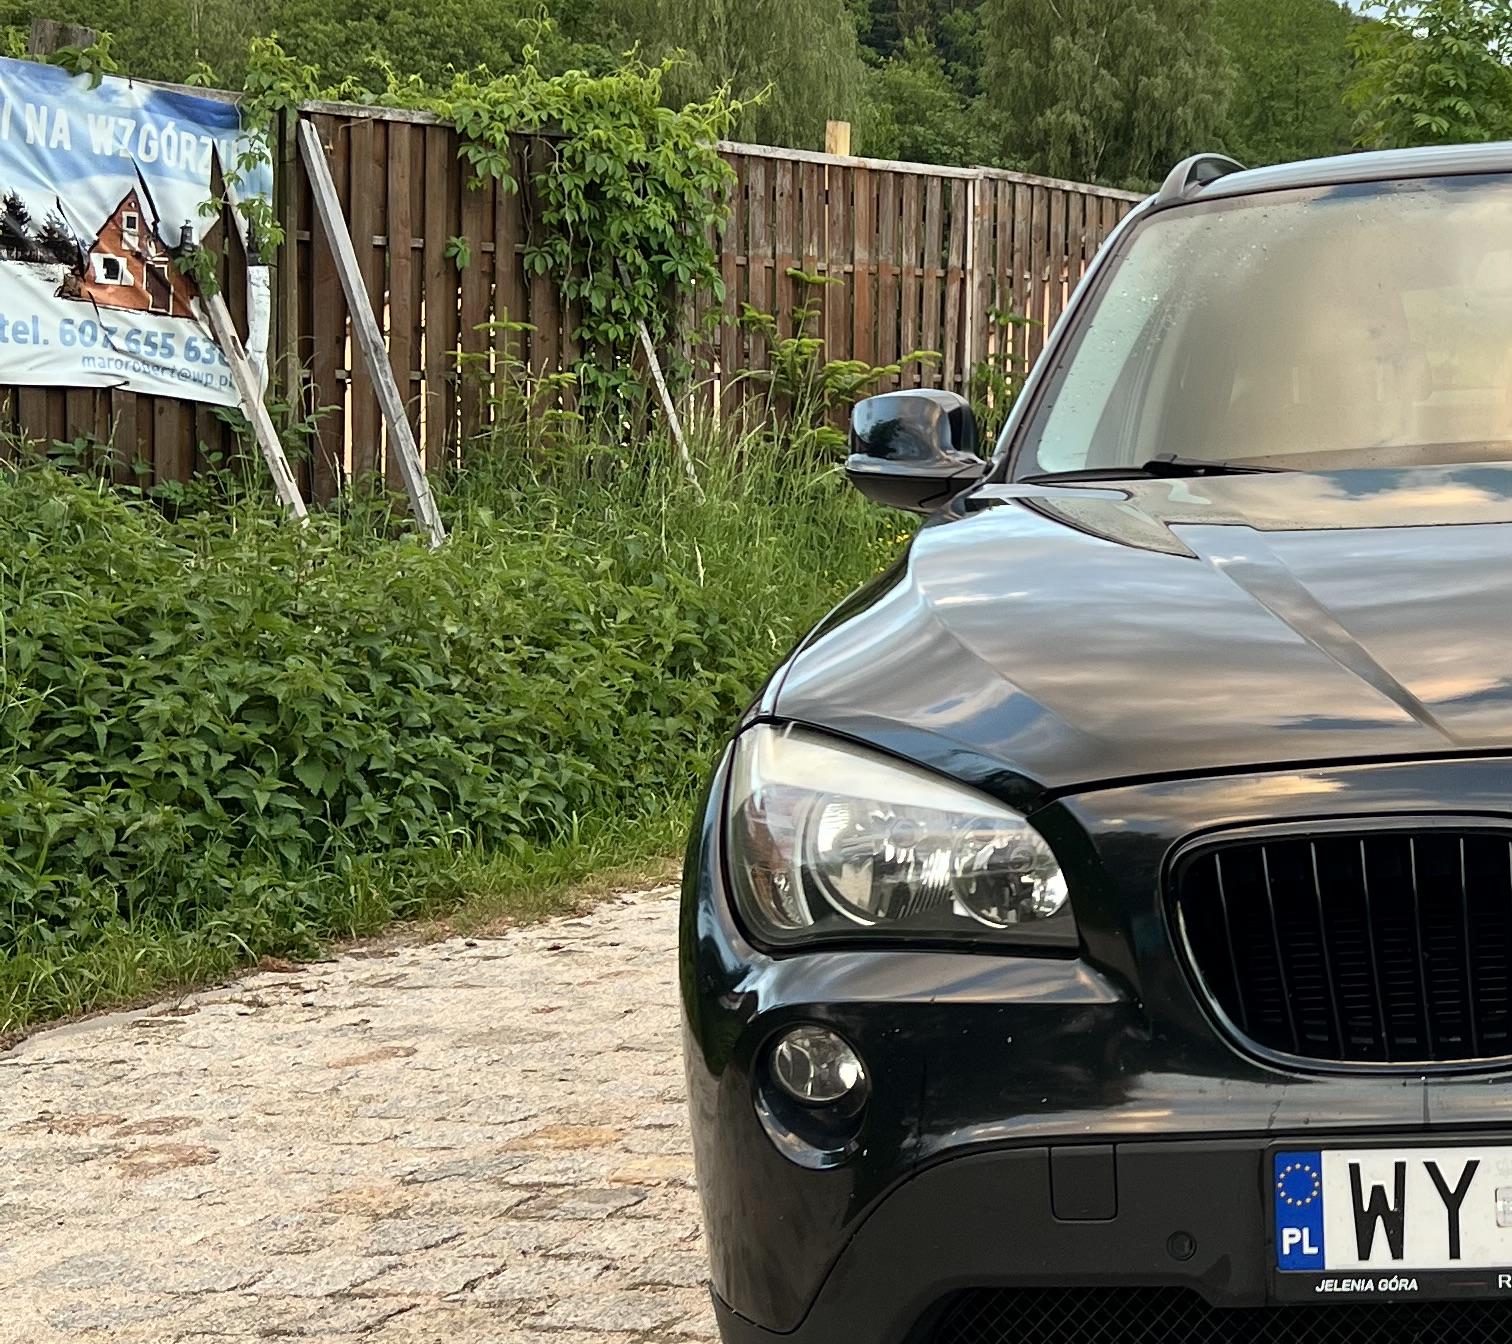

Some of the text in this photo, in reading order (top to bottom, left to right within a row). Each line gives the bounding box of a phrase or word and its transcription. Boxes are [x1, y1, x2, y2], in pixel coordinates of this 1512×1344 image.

[25, 102, 72, 150] NA
[0, 313, 49, 345] tel.
[125, 328, 175, 359] 655
[1348, 1159, 1481, 1261] WY
[1282, 1227, 1319, 1255] PL
[1315, 1274, 1419, 1293] JELENIA GÓRA
